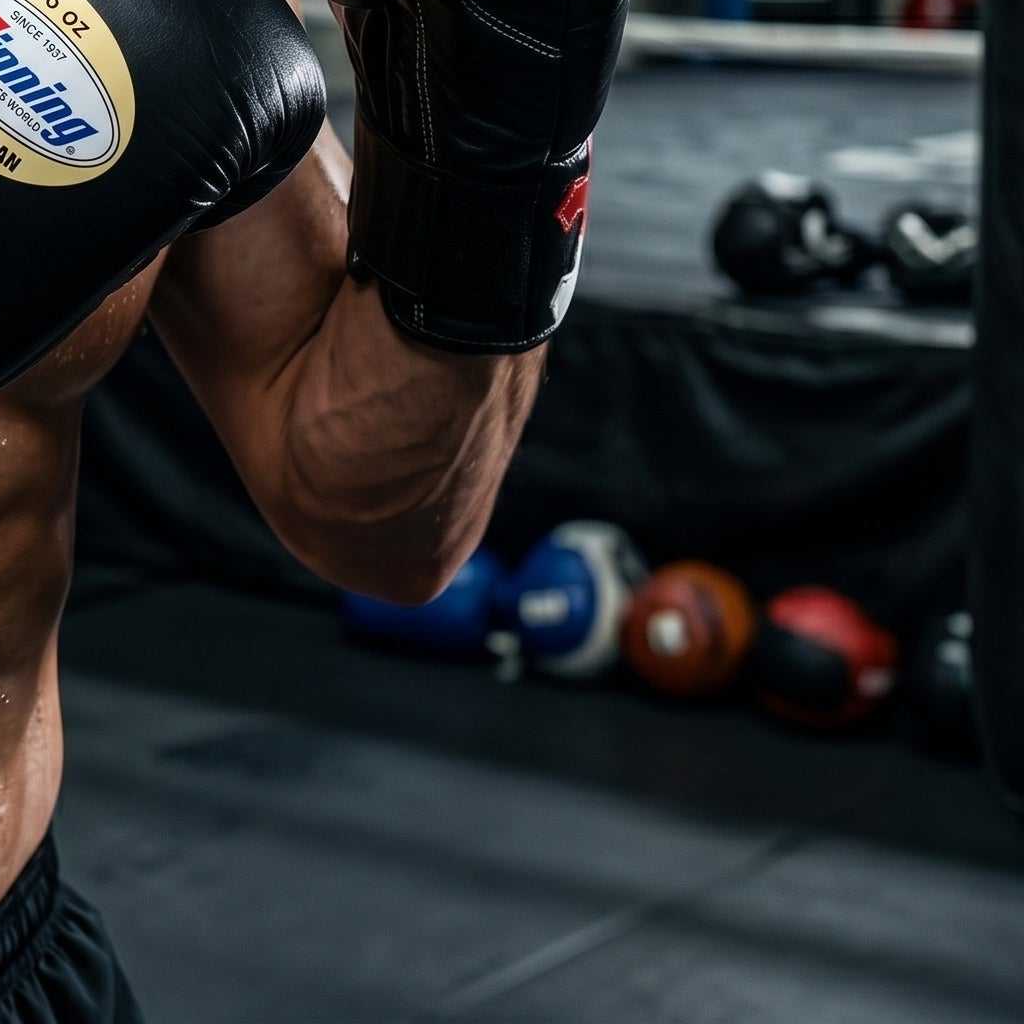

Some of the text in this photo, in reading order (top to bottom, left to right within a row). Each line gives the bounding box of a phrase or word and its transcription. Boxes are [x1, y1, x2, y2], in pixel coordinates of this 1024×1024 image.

[10, 10, 68, 61] SINCE 1937
[7, 98, 41, 132] WORLD
